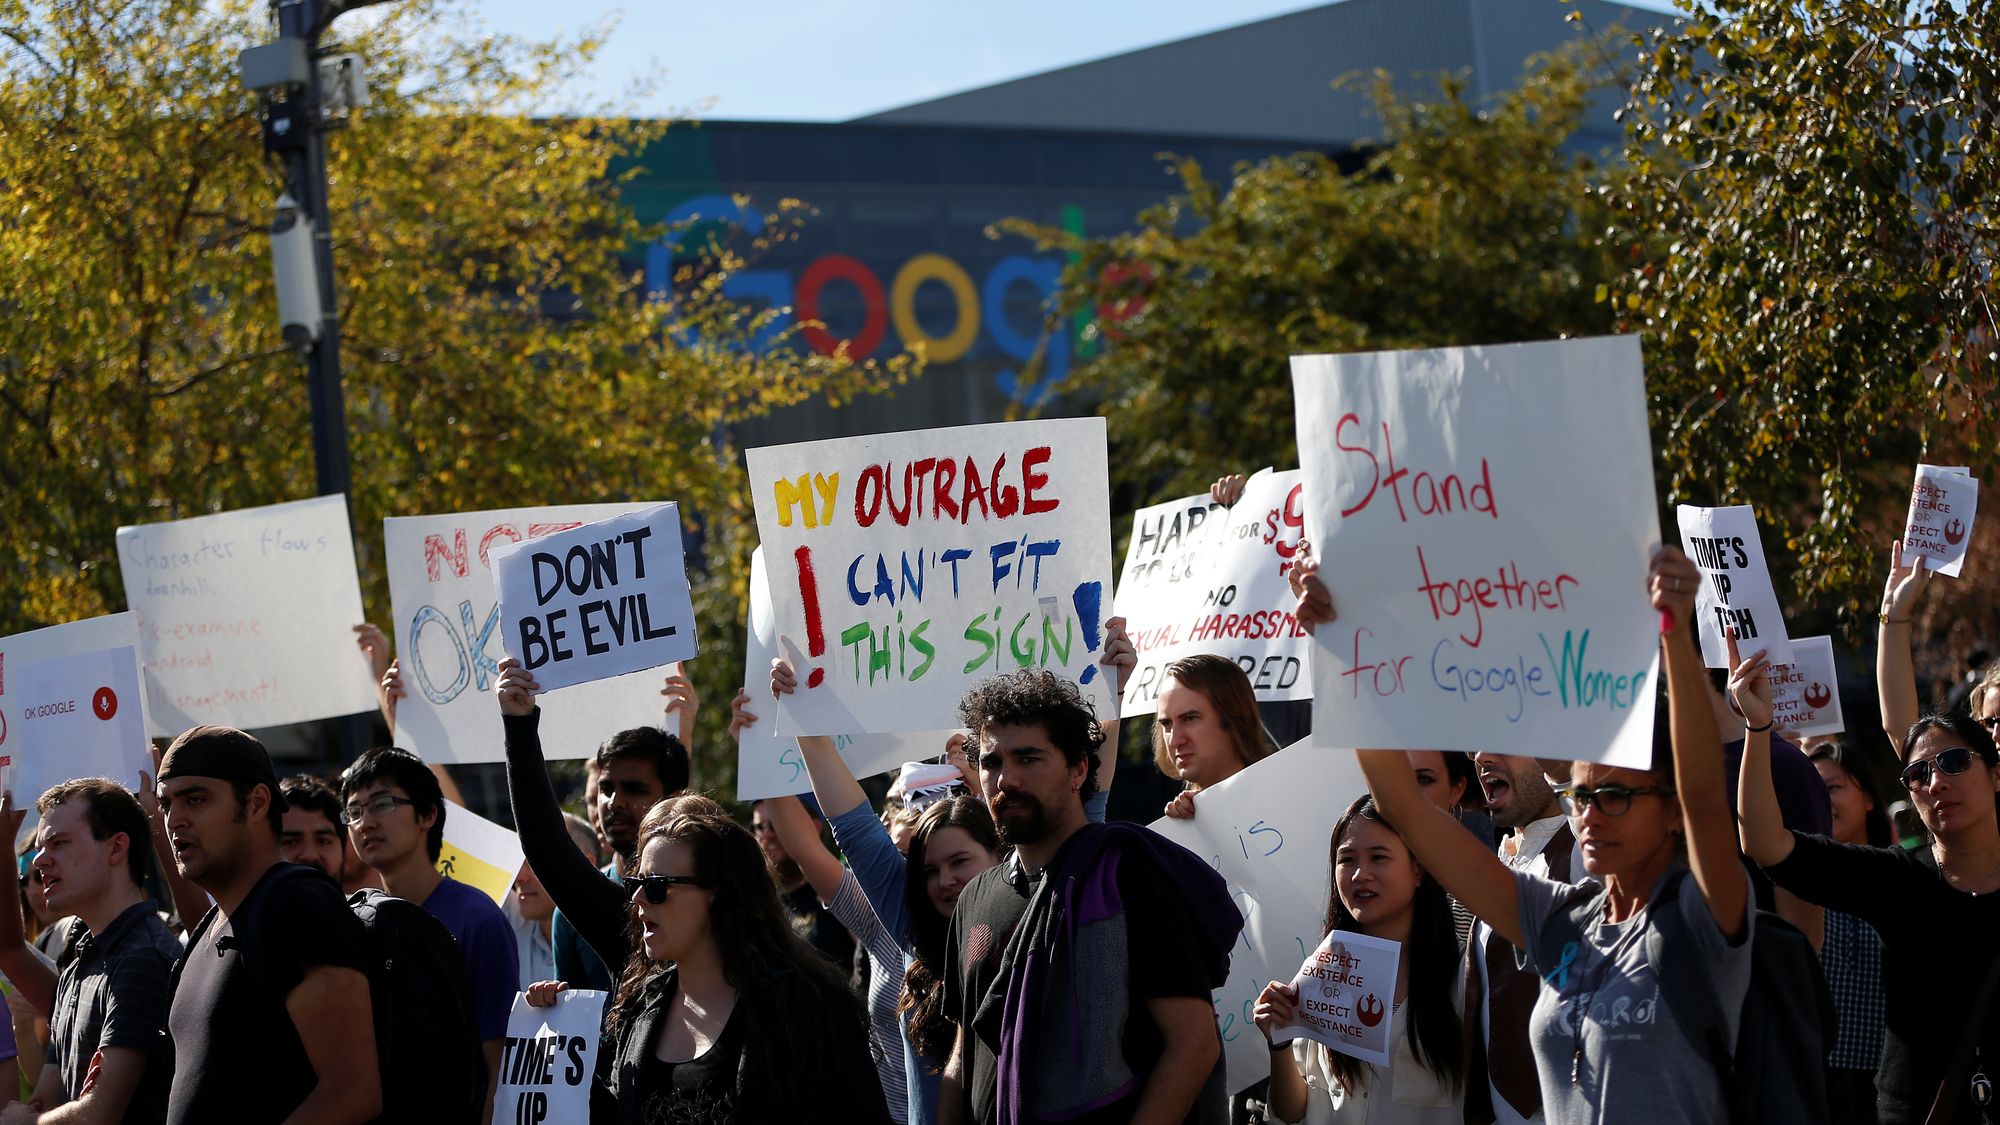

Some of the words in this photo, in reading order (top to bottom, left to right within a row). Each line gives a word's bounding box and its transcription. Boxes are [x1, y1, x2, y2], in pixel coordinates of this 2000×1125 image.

[1336, 412, 1498, 522] Stand
[774, 471, 839, 529] MY
[854, 446, 1060, 528] OUTRAGE
[1915, 512, 1931, 522] OR
[128, 533, 236, 570] Character
[532, 526, 651, 606] DON'T
[1690, 536, 1748, 570] TIME'S
[846, 547, 972, 608] CAN'T
[1711, 573, 1731, 605] UP
[1203, 585, 1237, 607] NO
[1416, 545, 1579, 648] together
[519, 609, 573, 670] BE
[578, 593, 676, 656] EVIL
[1341, 627, 1413, 699] for
[24, 707, 37, 720] OK
[38, 700, 76, 717] GOOGLE
[1303, 966, 1363, 987] EXISTENCE
[1314, 951, 1361, 969] RESPECT
[1306, 999, 1351, 1019] EXPECT
[1323, 986, 1341, 1000] OR
[1298, 1010, 1363, 1038] RESISTANCE
[502, 1035, 587, 1087] TIME'S
[516, 1092, 548, 1125] UP
